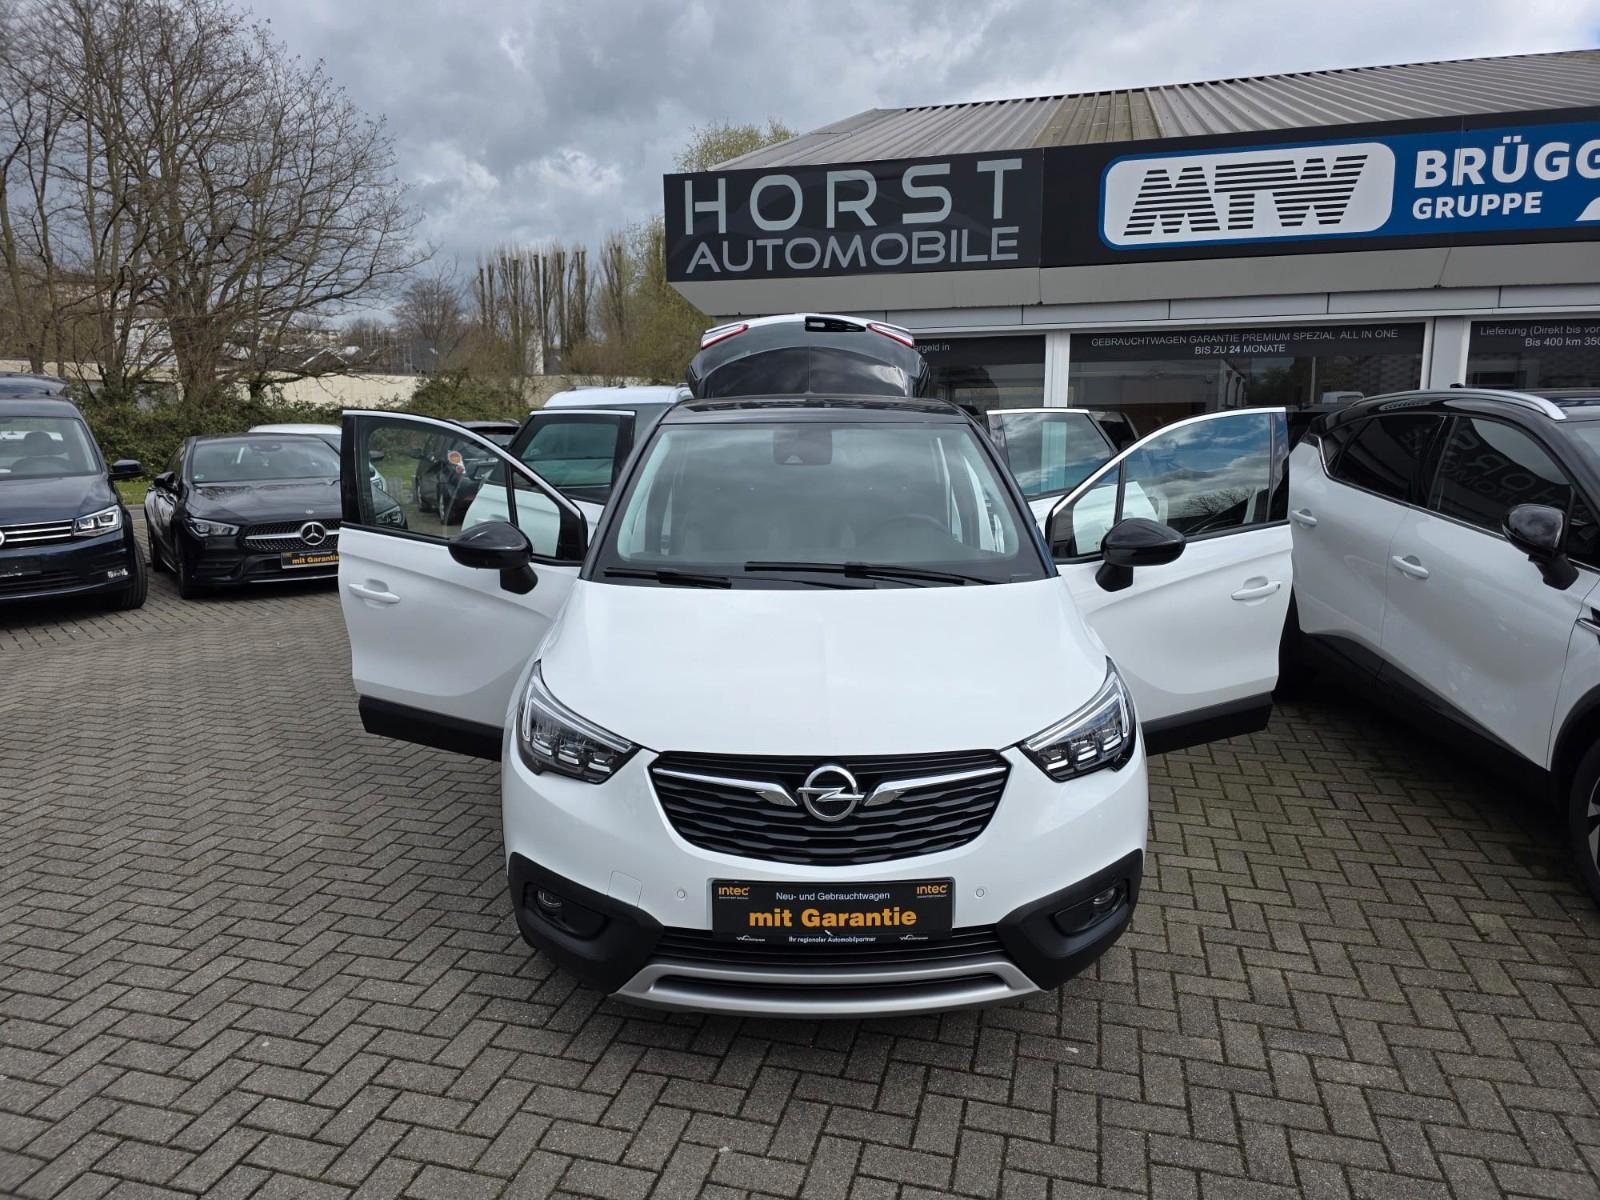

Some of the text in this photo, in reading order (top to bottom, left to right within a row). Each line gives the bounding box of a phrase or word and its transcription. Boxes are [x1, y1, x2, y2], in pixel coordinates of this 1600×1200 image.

[1414, 135, 1600, 188] BRÜGG
[685, 158, 1023, 235] HORST
[1123, 154, 1368, 236] MTW
[1412, 191, 1543, 220] GRUPPE
[685, 226, 1019, 274] AUTOMOBILE
[1091, 329, 1399, 347] GEBRAUCHTWAGEN GARANTIE PREMIUM SPEZIAL ALL IN ONE
[1480, 327, 1527, 336] Lieferung
[1530, 325, 1563, 336] (Direkt
[1566, 325, 1581, 334] bis
[942, 342, 950, 351] in
[1194, 343, 1286, 355] BIS ZU 24 MONATE
[1525, 337, 1541, 347] Bis
[1543, 337, 1563, 347] 400
[1565, 336, 1581, 346] km
[718, 886, 749, 896] intec
[776, 892, 890, 902] Neu- und Gebrauchtwagen
[916, 884, 947, 895] intec
[749, 906, 917, 927] mit Garantie
